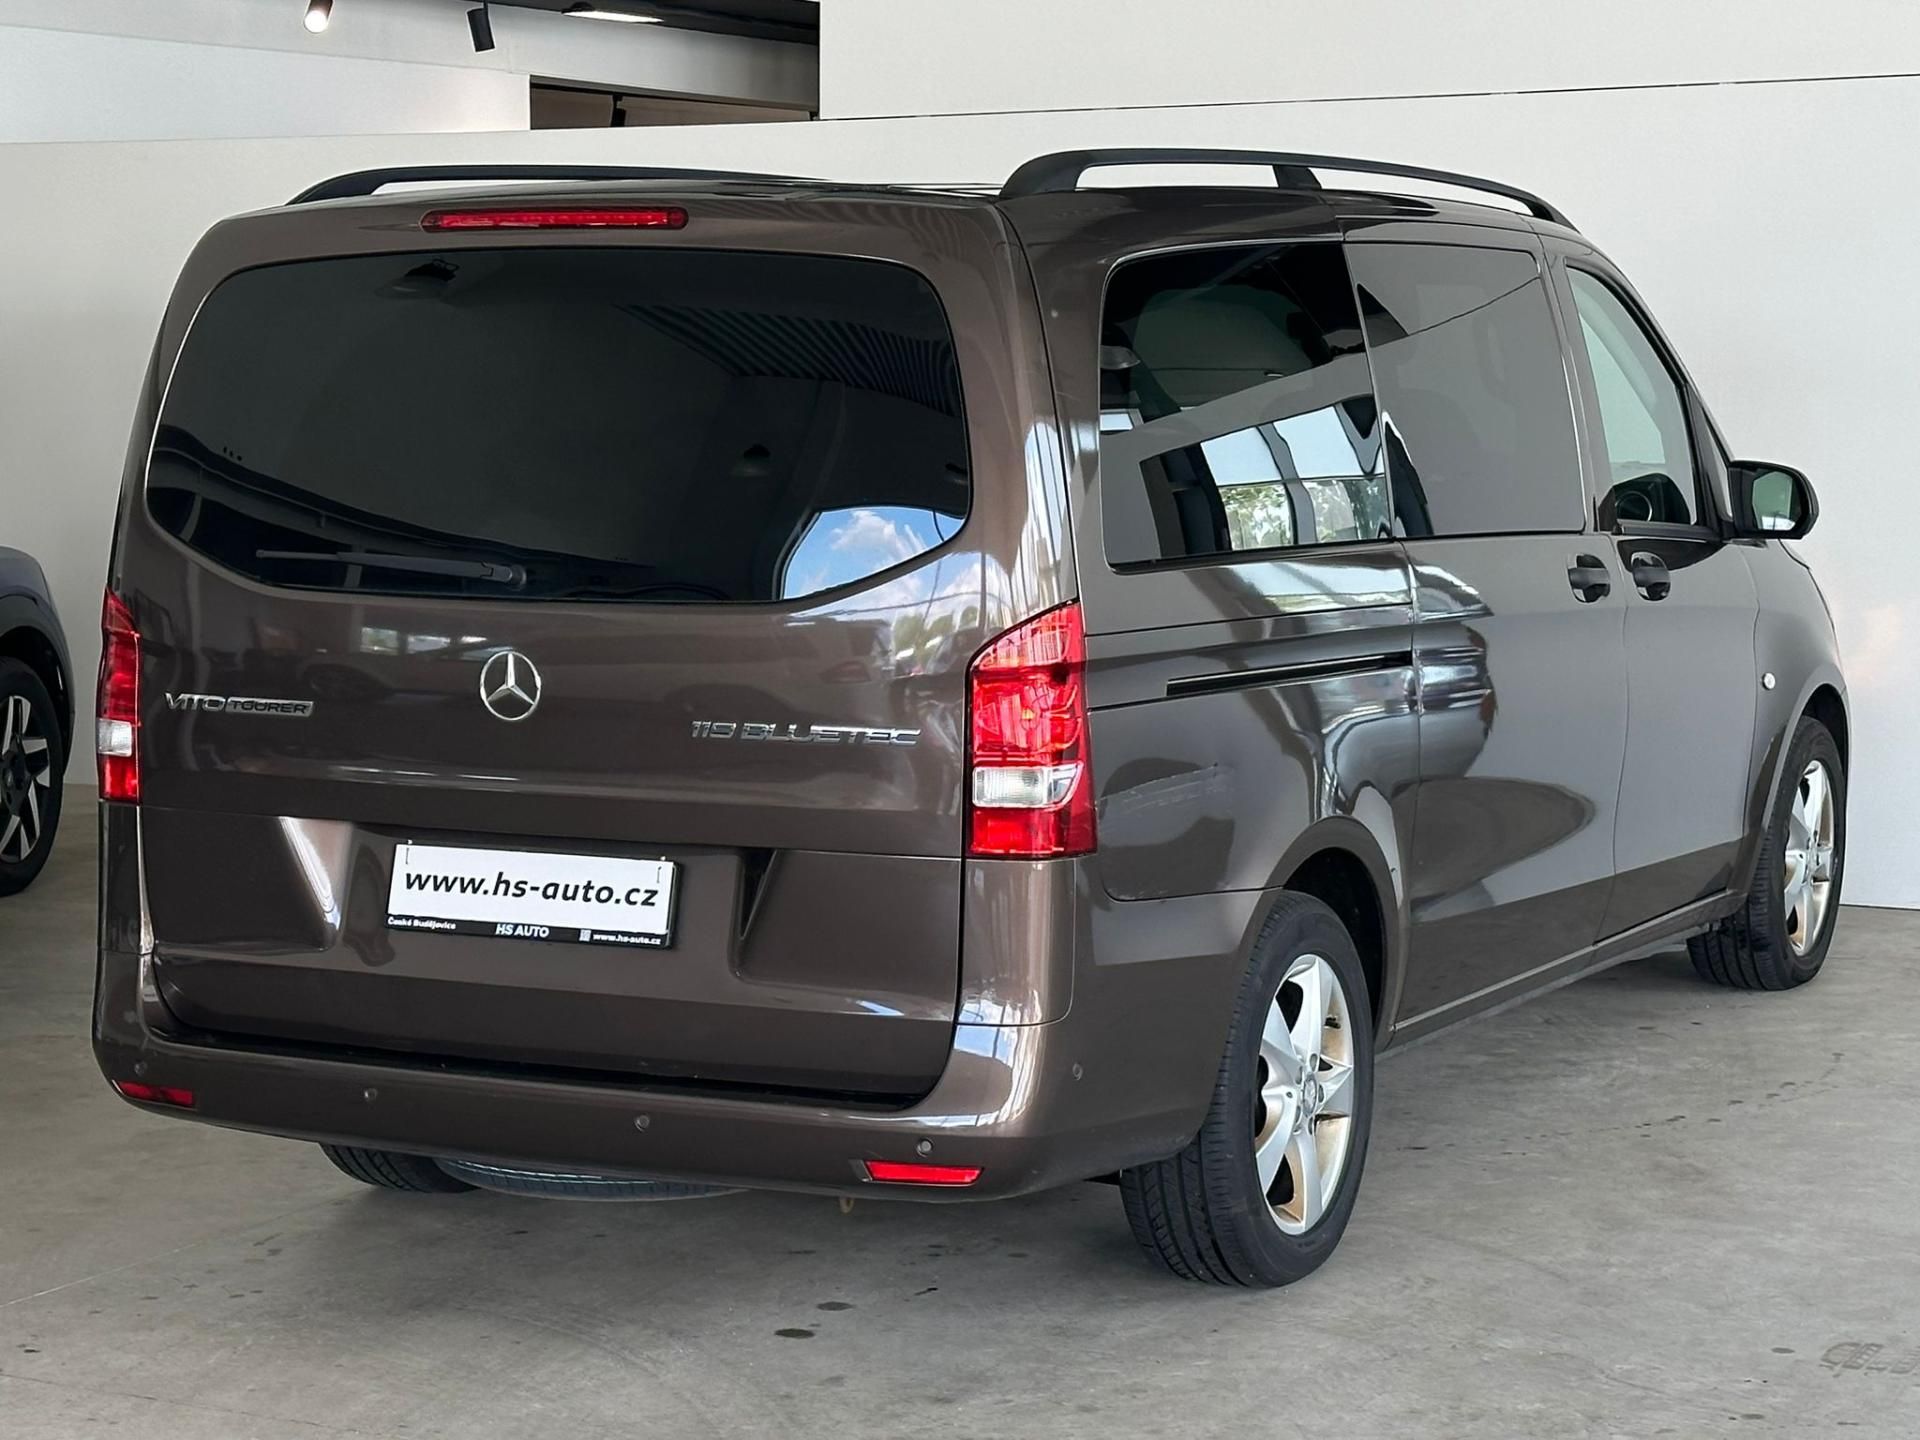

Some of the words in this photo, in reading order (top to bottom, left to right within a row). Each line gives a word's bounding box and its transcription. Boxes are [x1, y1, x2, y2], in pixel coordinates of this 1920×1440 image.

[165, 692, 226, 712] VITO
[230, 698, 312, 717] TOURER
[692, 720, 737, 739] 119
[740, 722, 921, 744] BLUETEC
[405, 871, 658, 907] www.hs-auto.cz
[495, 923, 514, 936] HS
[514, 924, 550, 938] AUTO
[593, 933, 661, 945] www.hs-auto.cz
